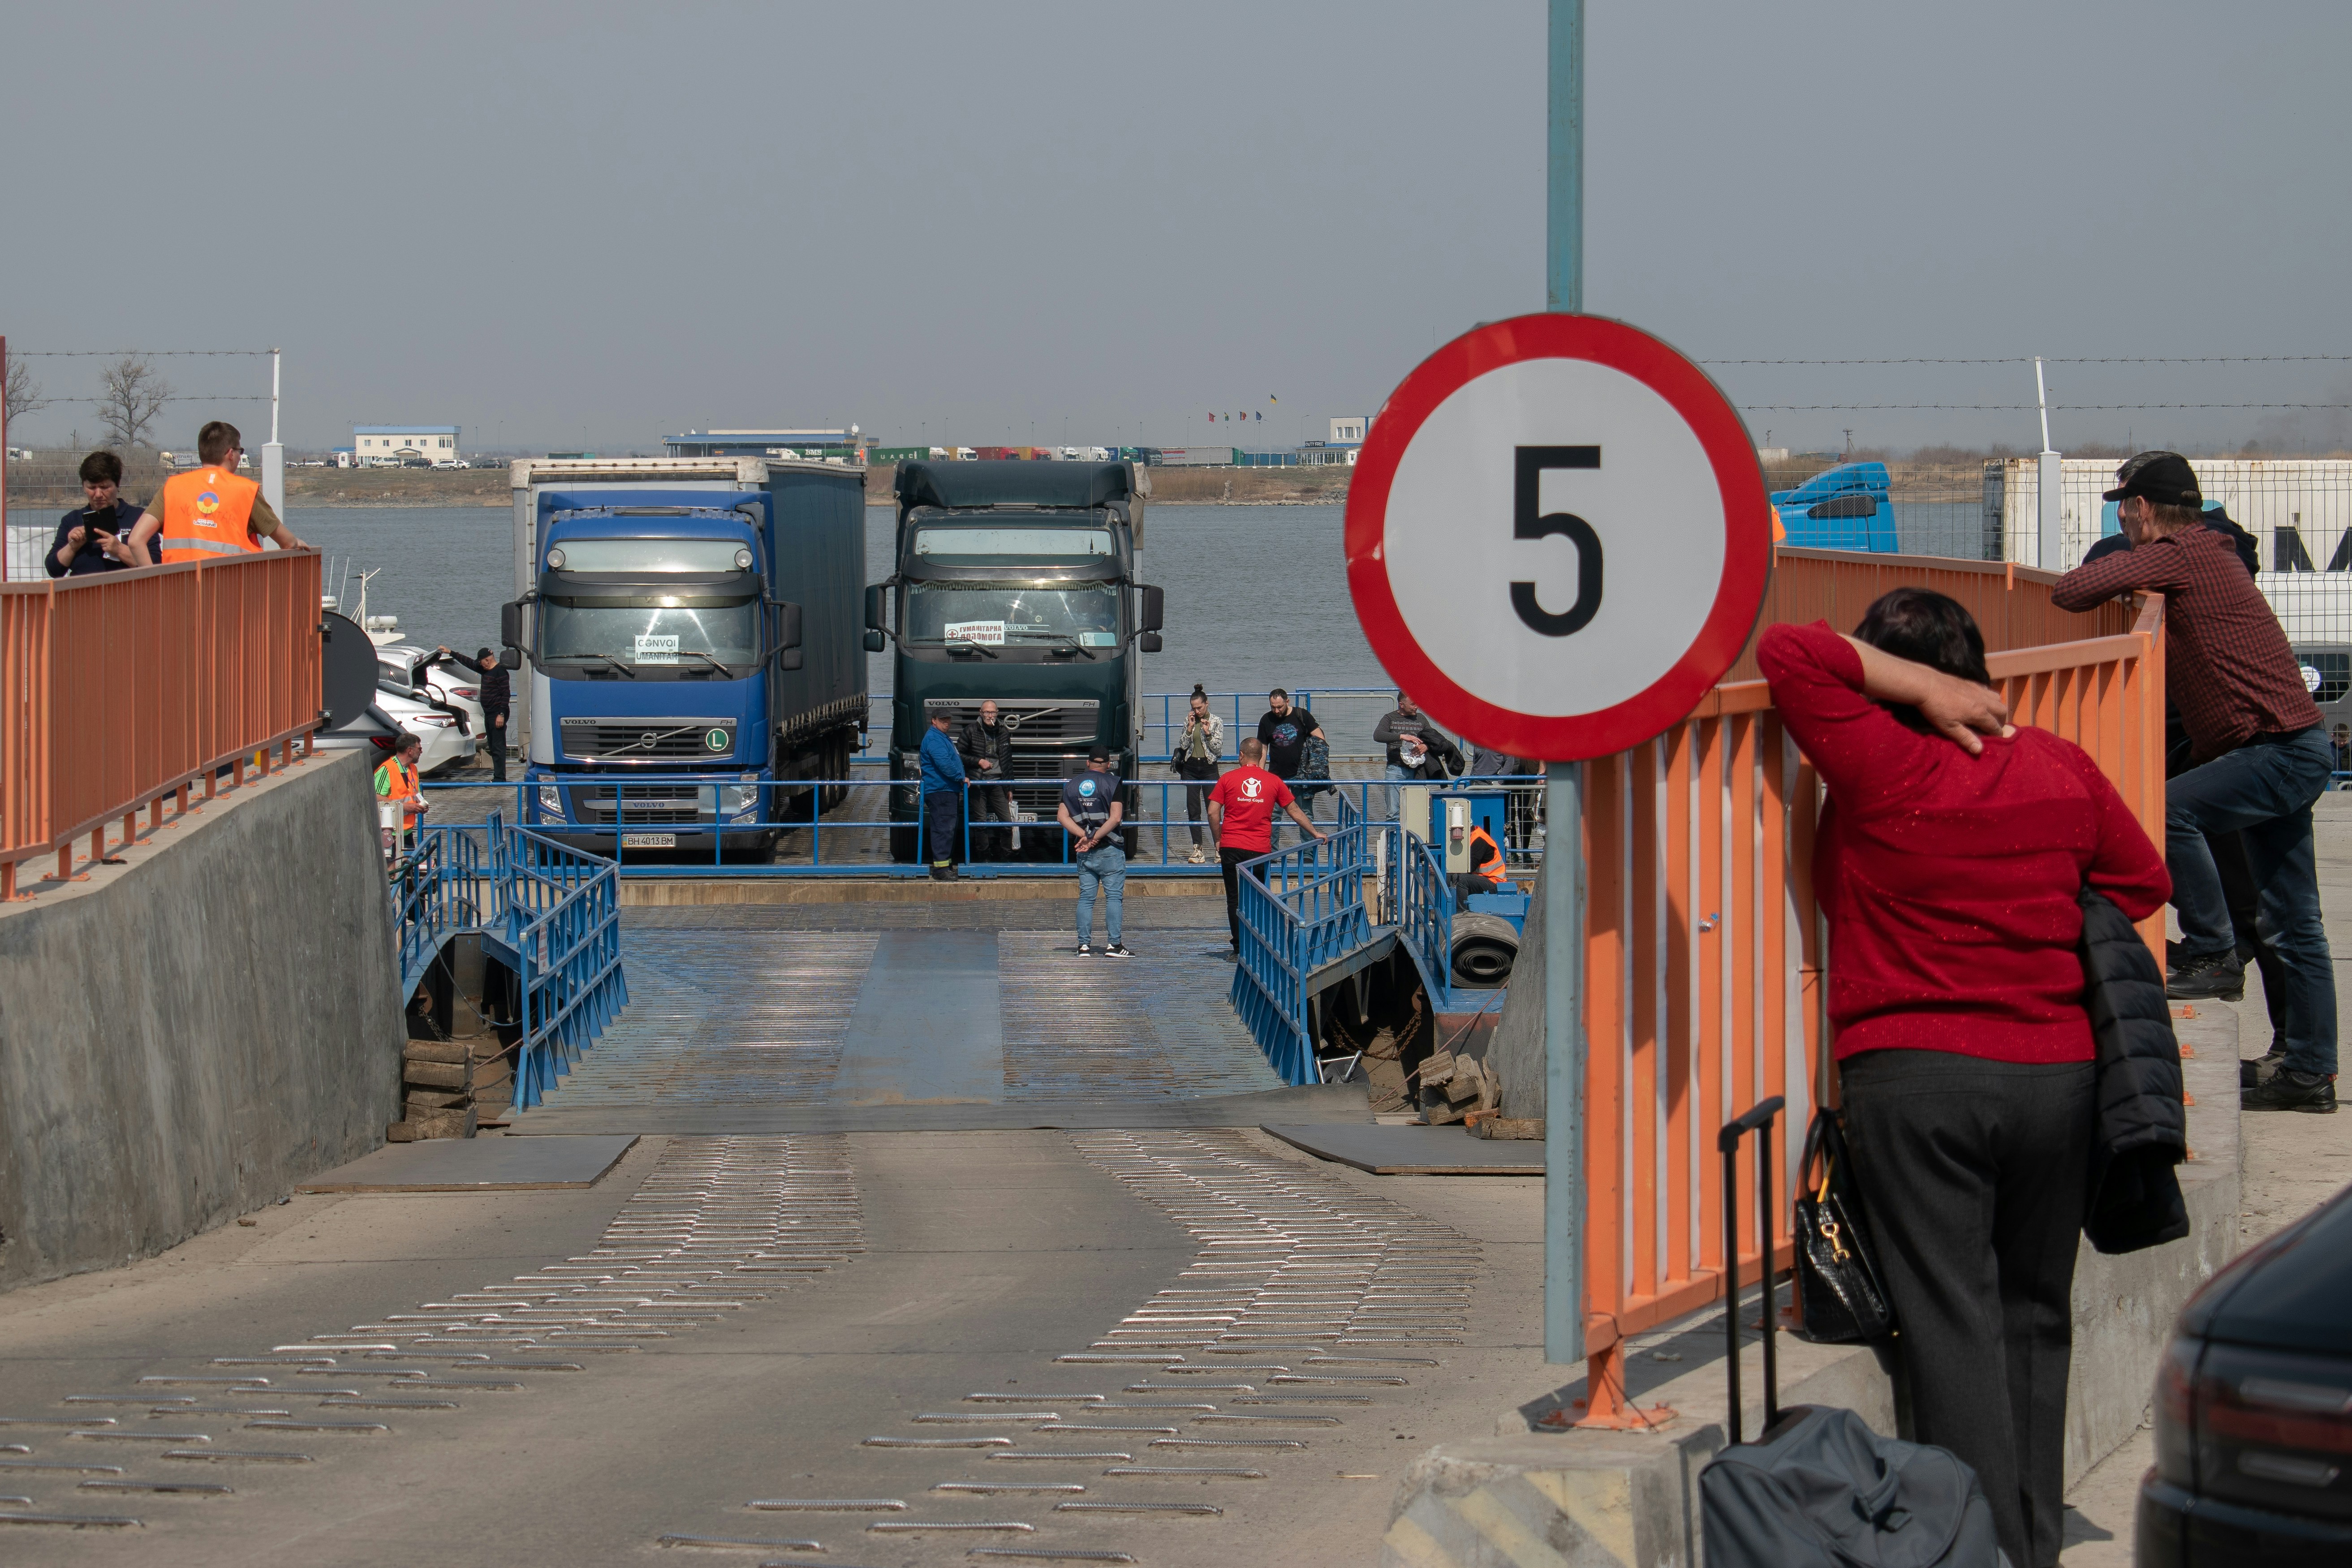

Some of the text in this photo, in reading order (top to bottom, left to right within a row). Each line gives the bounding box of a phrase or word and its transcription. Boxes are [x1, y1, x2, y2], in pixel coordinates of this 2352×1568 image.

[1509, 445, 1603, 637] 5
[713, 733, 722, 747] L
[628, 837, 673, 845] BH 4013 BM
